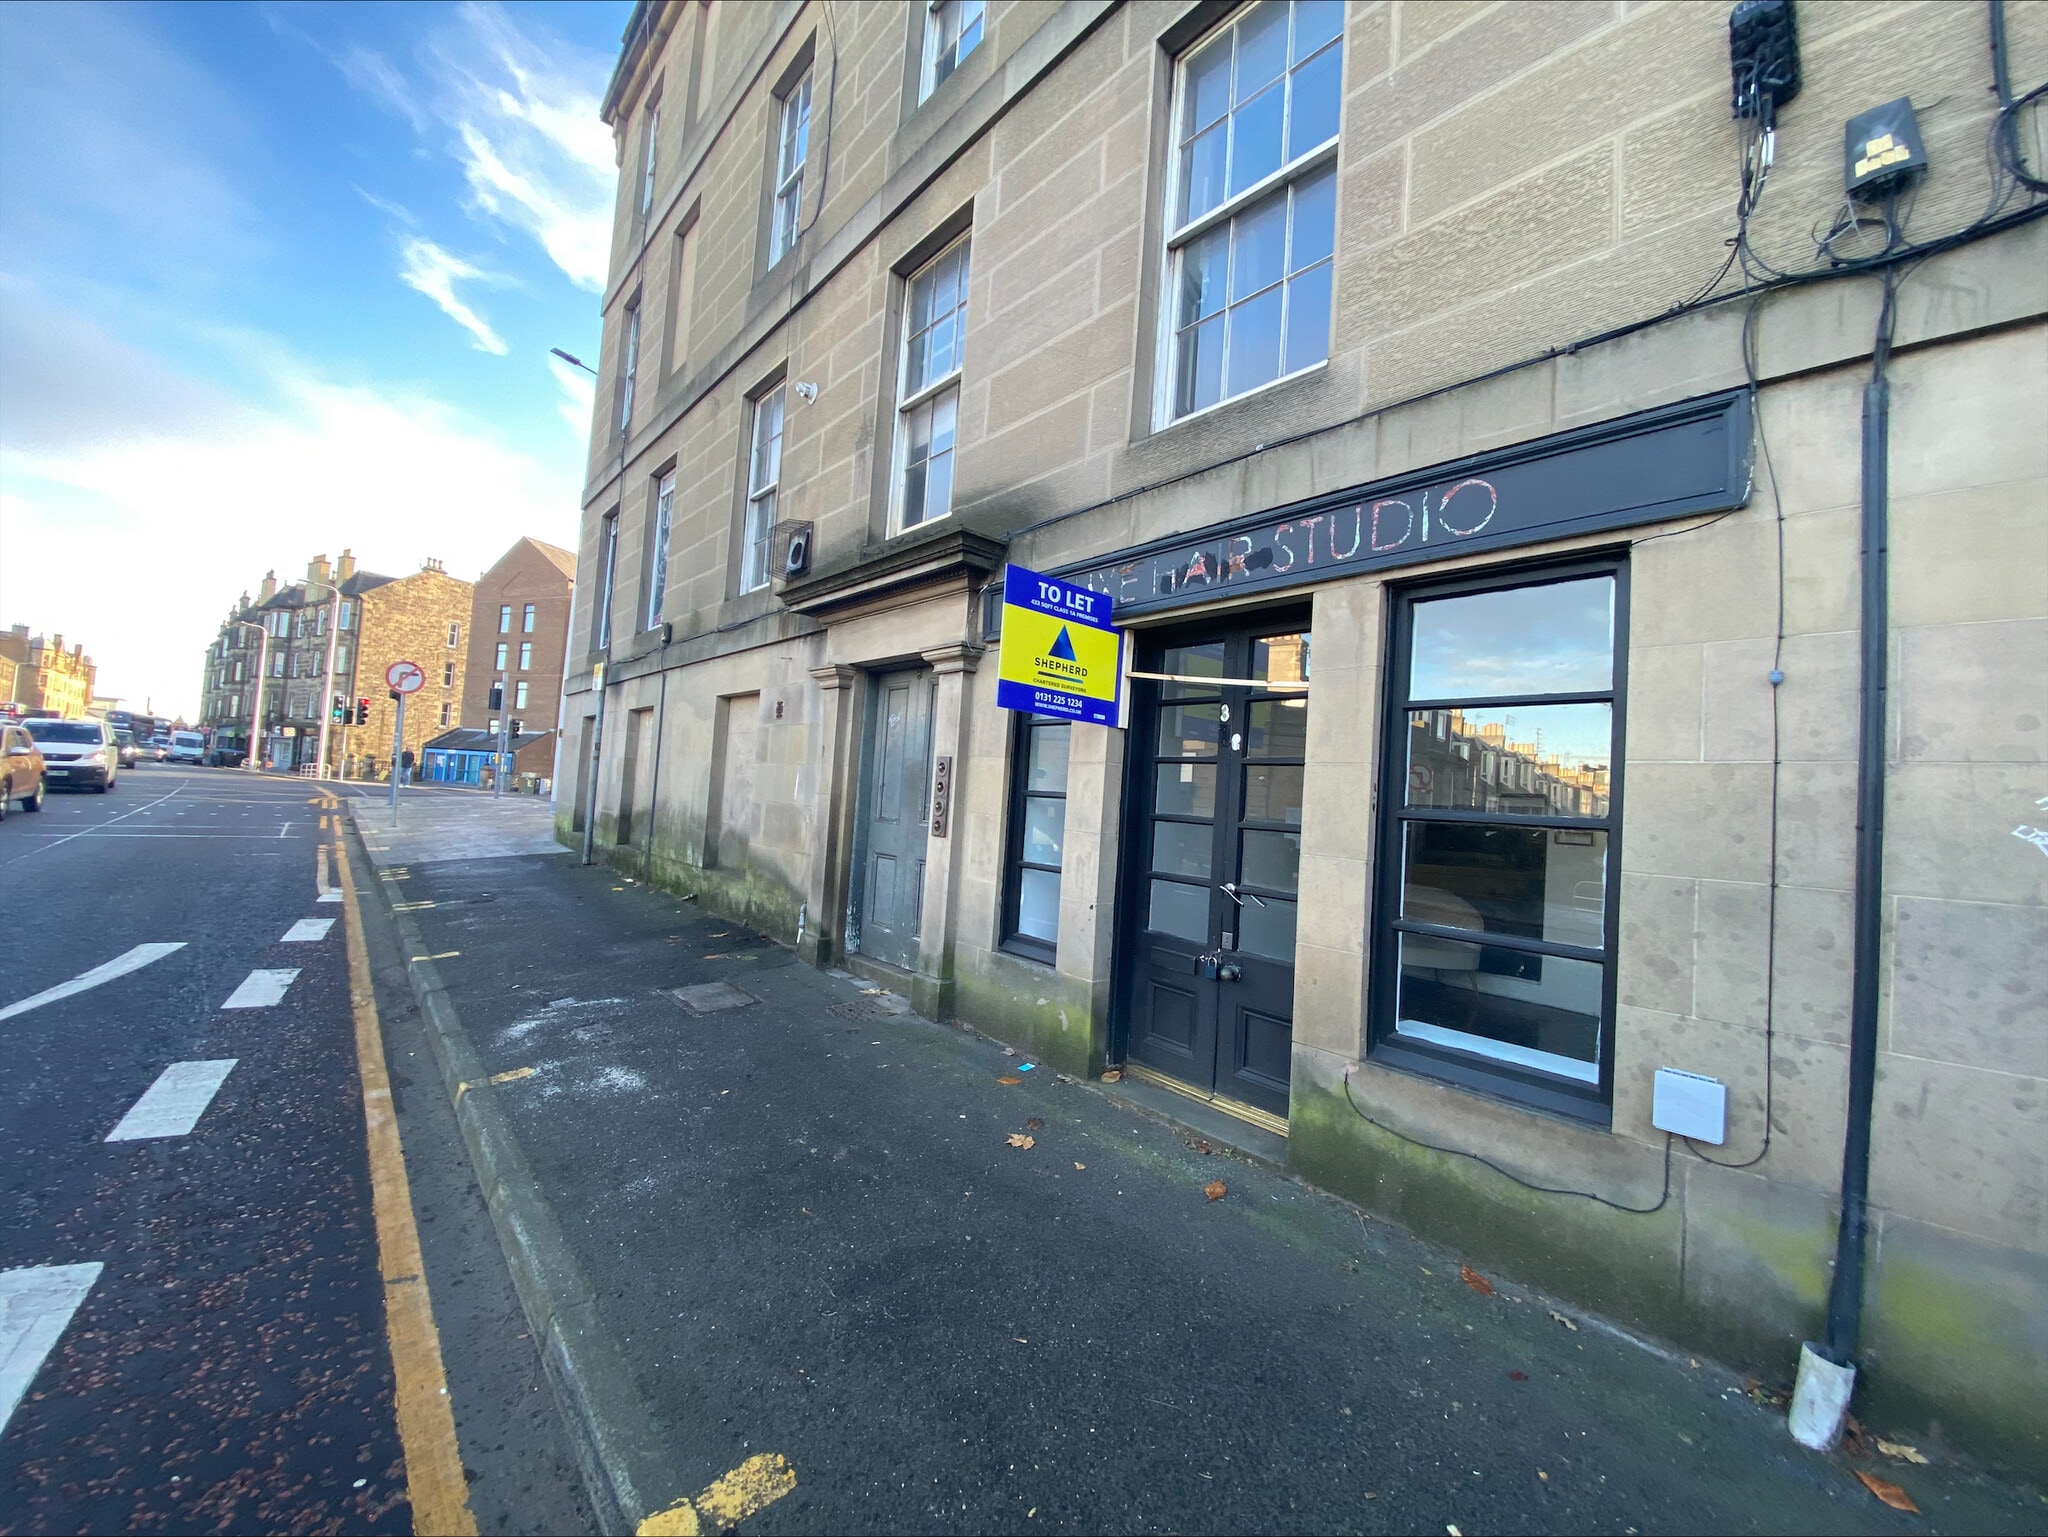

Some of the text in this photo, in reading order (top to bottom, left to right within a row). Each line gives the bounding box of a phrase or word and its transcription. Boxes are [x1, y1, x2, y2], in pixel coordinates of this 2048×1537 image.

[1273, 479, 1498, 573] STUDIO
[1038, 581, 1061, 603] TO
[1066, 590, 1094, 613] LET
[1041, 601, 1053, 610] SQFT
[1053, 605, 1069, 615] CLASS
[1076, 612, 1099, 623] PREMISES
[1034, 657, 1088, 677] SHEPHERD
[1032, 677, 1087, 693] CHARTERED SURVEYORS
[1034, 691, 1083, 708] 0131 225 1234
